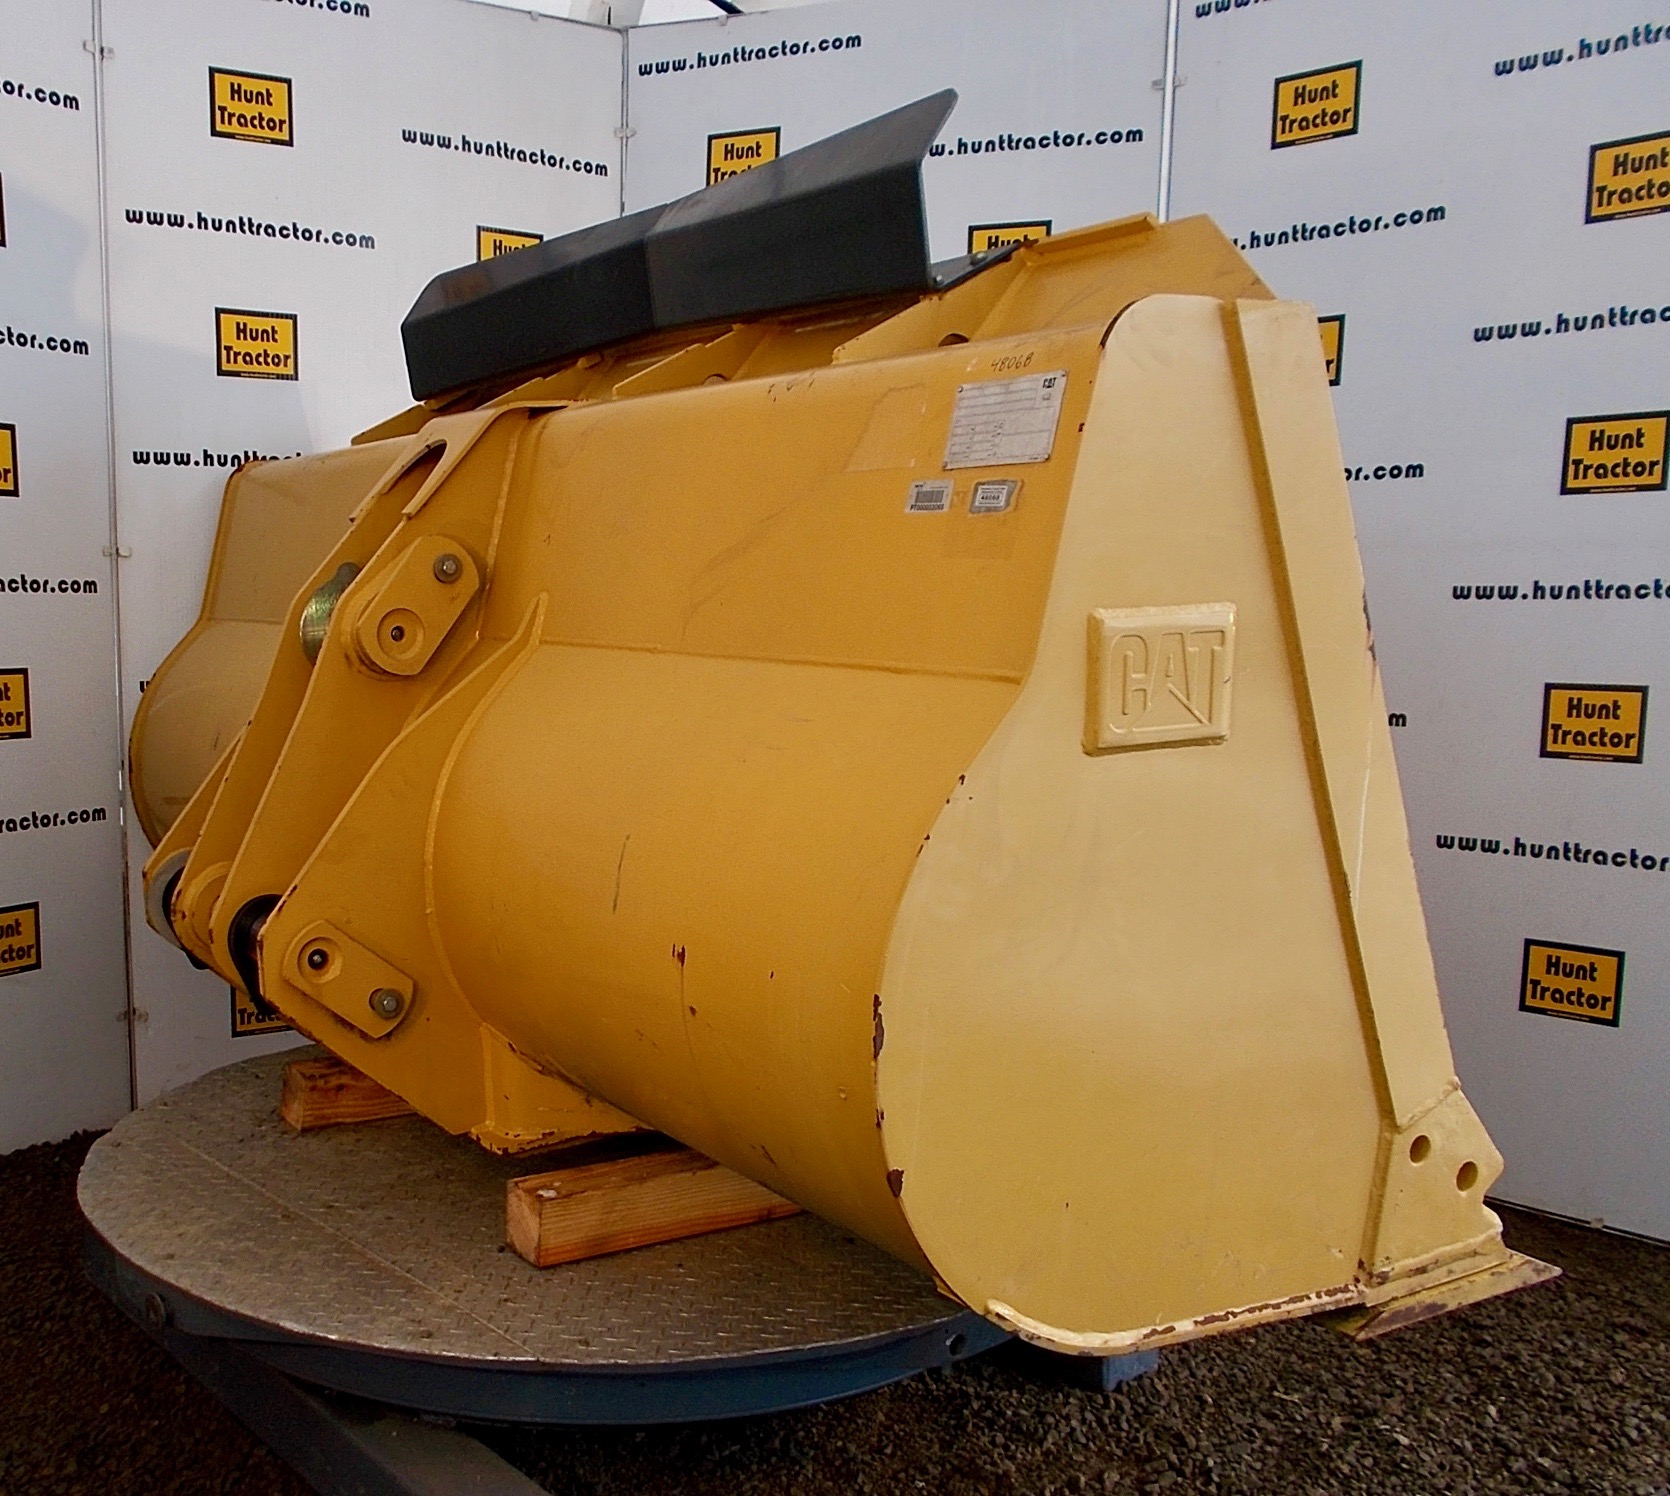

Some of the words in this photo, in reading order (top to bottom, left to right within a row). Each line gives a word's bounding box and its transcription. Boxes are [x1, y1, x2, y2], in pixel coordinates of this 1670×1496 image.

[638, 33, 862, 77] www.hunttractor.com
[230, 82, 273, 106] Hunt
[1293, 79, 1339, 106] Hunt
[218, 105, 287, 133] Tractor
[1279, 107, 1352, 135] Tractor
[402, 128, 608, 177] www.hunttractor.com
[724, 141, 762, 161] Hunt
[1612, 146, 1670, 176] Hunt
[125, 208, 376, 250] www.hunttractor.com
[1231, 205, 1446, 251] .hunttractor.com
[236, 321, 279, 343] Hunt
[223, 344, 291, 368] Tractor
[1588, 427, 1646, 452] Hunt
[1571, 457, 1660, 480] Tractor
[1109, 630, 1226, 733] CAT
[1567, 697, 1621, 720] Hunt
[1550, 723, 1636, 749] Tractor
[1545, 954, 1598, 982] Hunt
[1529, 978, 1612, 1011] Tractor
